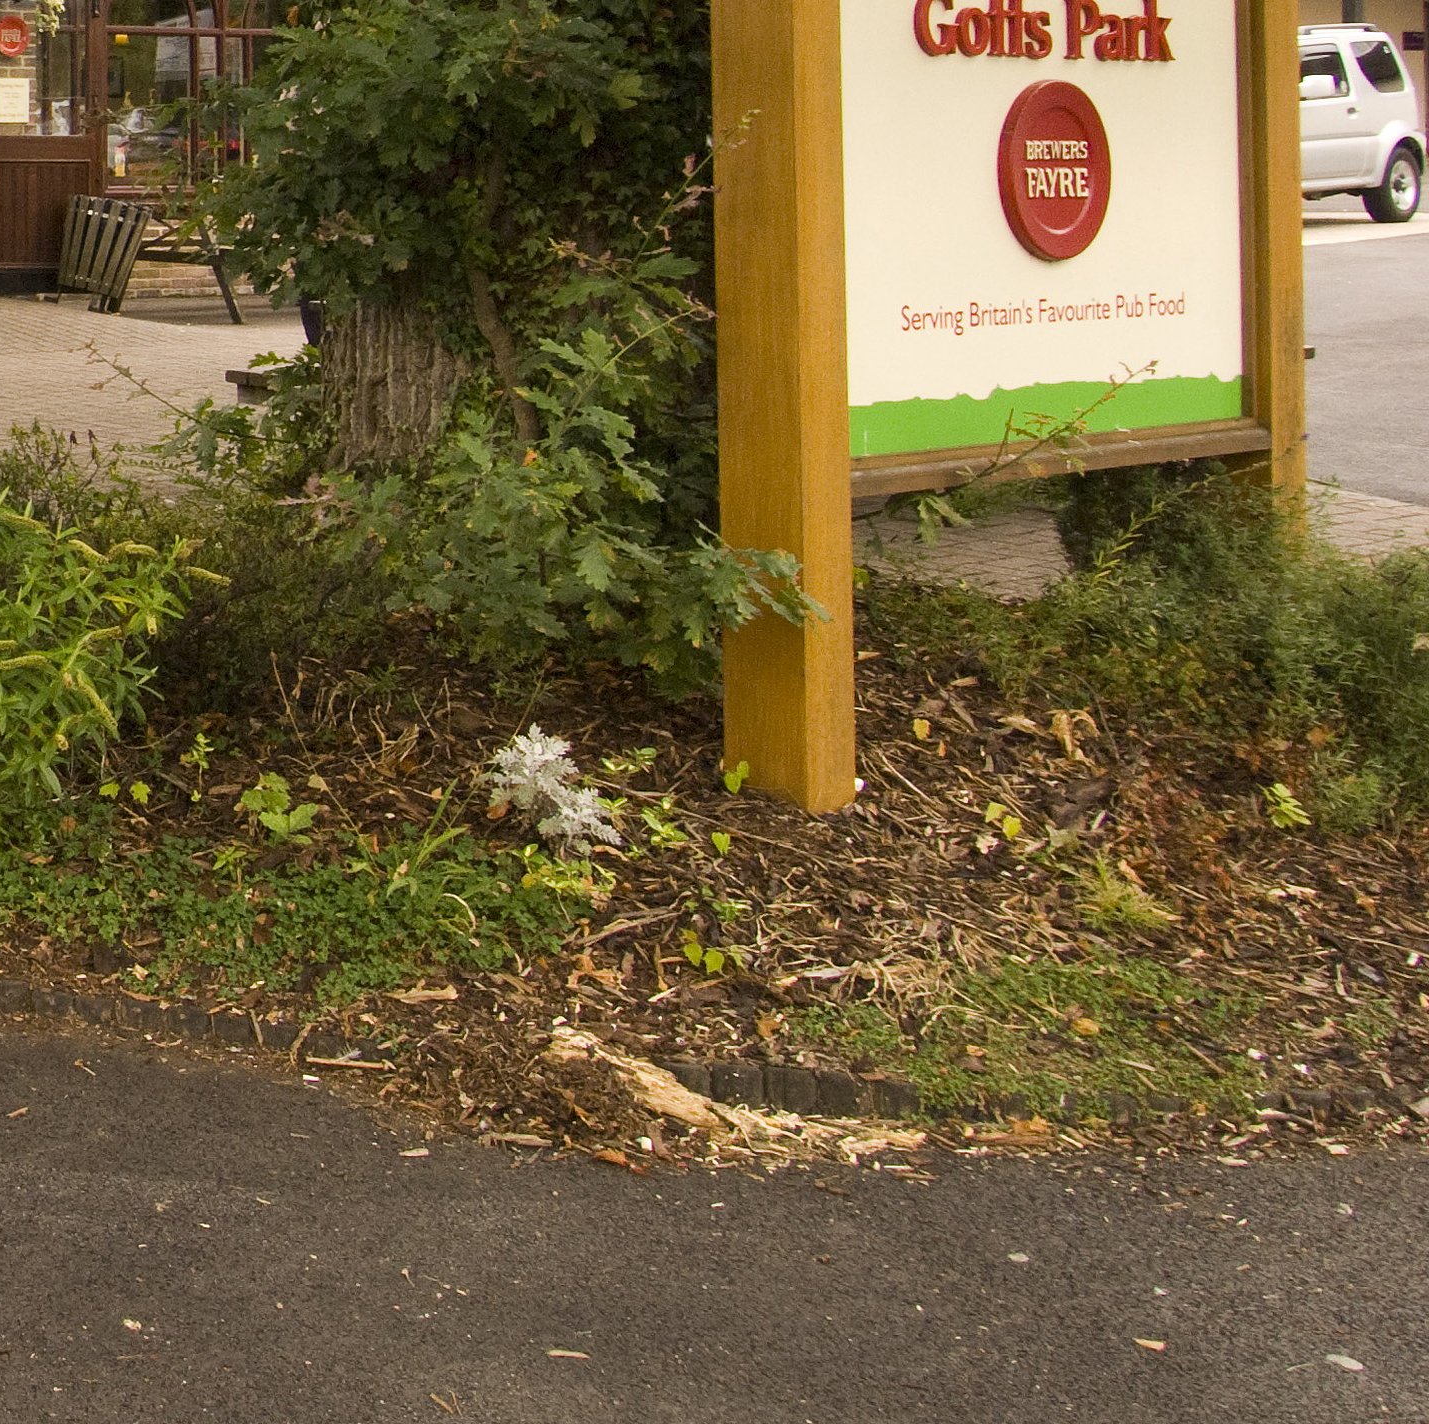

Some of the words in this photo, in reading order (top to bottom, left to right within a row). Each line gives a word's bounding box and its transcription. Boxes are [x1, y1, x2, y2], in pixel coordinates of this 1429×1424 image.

[1025, 140, 1088, 161] BREWERS
[1024, 167, 1090, 198] FAYRE
[901, 305, 964, 336] Serving
[969, 300, 1033, 327] Britain's
[1038, 297, 1111, 323] Favourite
[1115, 294, 1144, 319] Pub
[1148, 291, 1186, 317] Food
